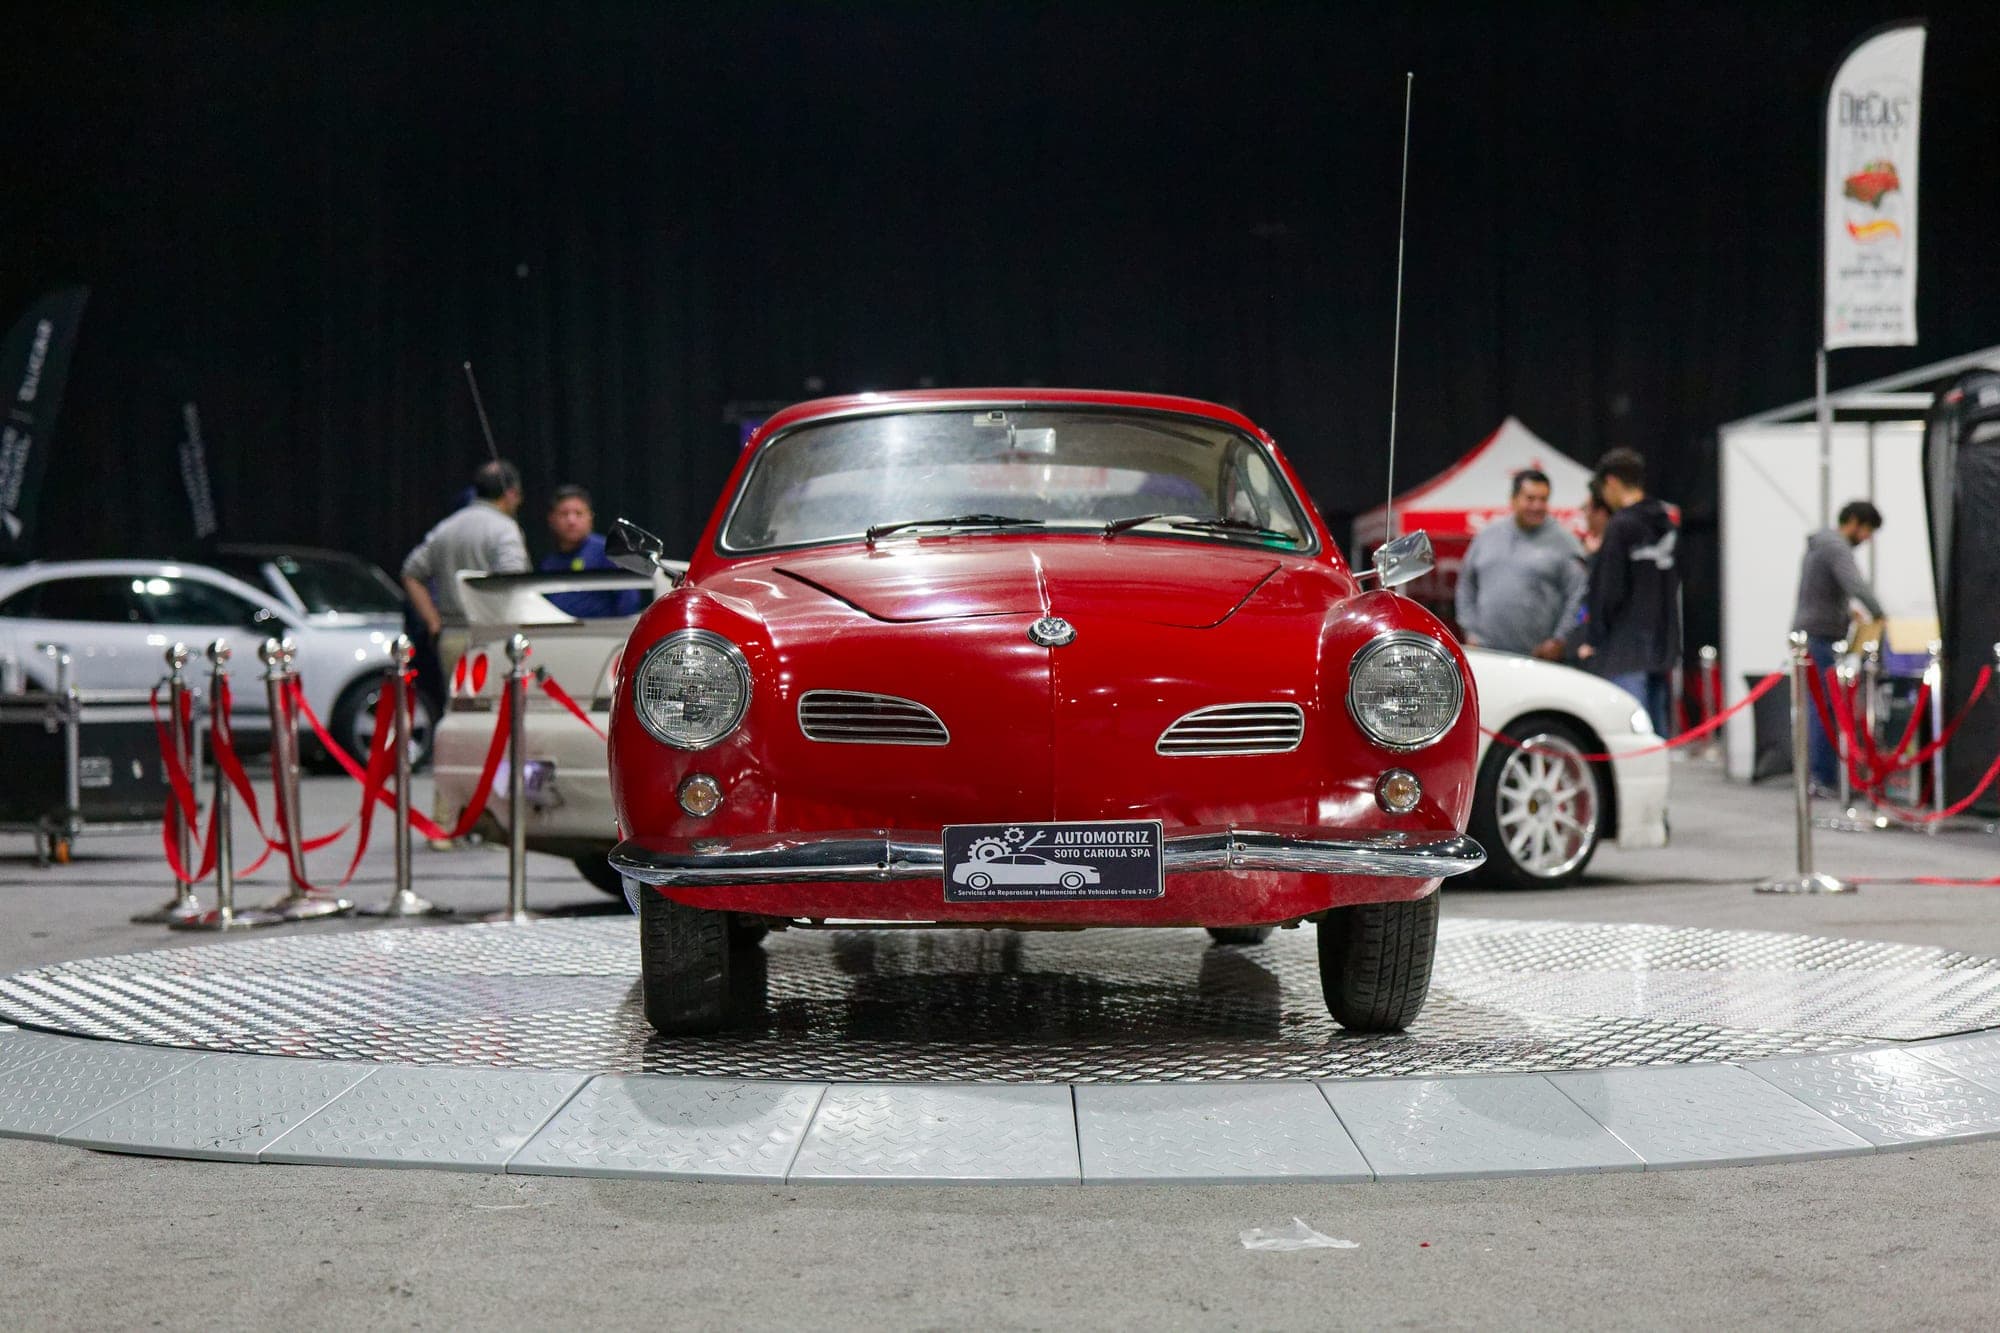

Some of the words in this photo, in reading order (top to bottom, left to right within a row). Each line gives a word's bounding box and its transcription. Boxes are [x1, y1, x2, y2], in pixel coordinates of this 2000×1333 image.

[1054, 831, 1149, 844] AUTOMOTRIZ
[1054, 849, 1080, 858] SOTO
[1083, 848, 1127, 858] CARIOLA
[1130, 848, 1151, 858] SPA
